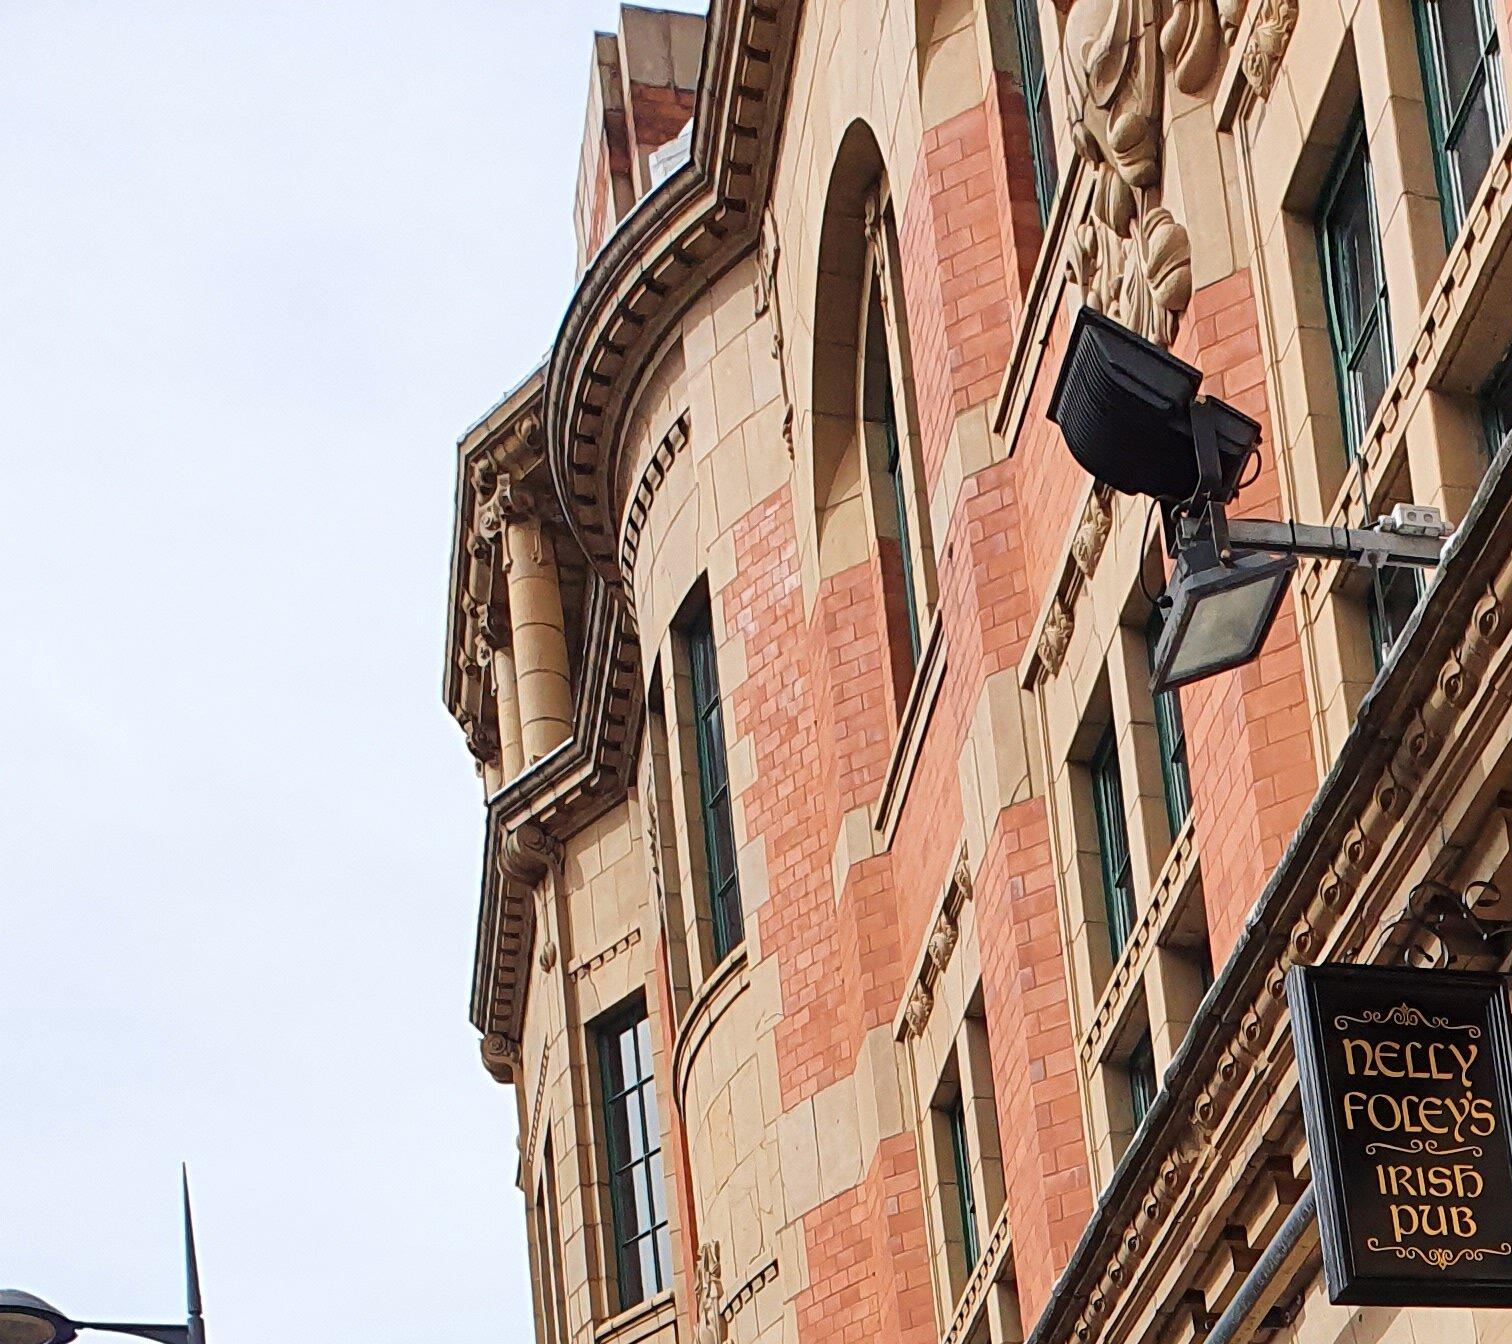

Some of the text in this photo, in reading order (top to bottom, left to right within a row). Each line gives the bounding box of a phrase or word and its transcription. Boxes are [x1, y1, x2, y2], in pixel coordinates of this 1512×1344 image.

[1342, 1038, 1478, 1087] NELLY
[1343, 1090, 1496, 1142] FOLEY'S
[1376, 1164, 1484, 1198] IRISH
[1389, 1204, 1477, 1242] PUB
